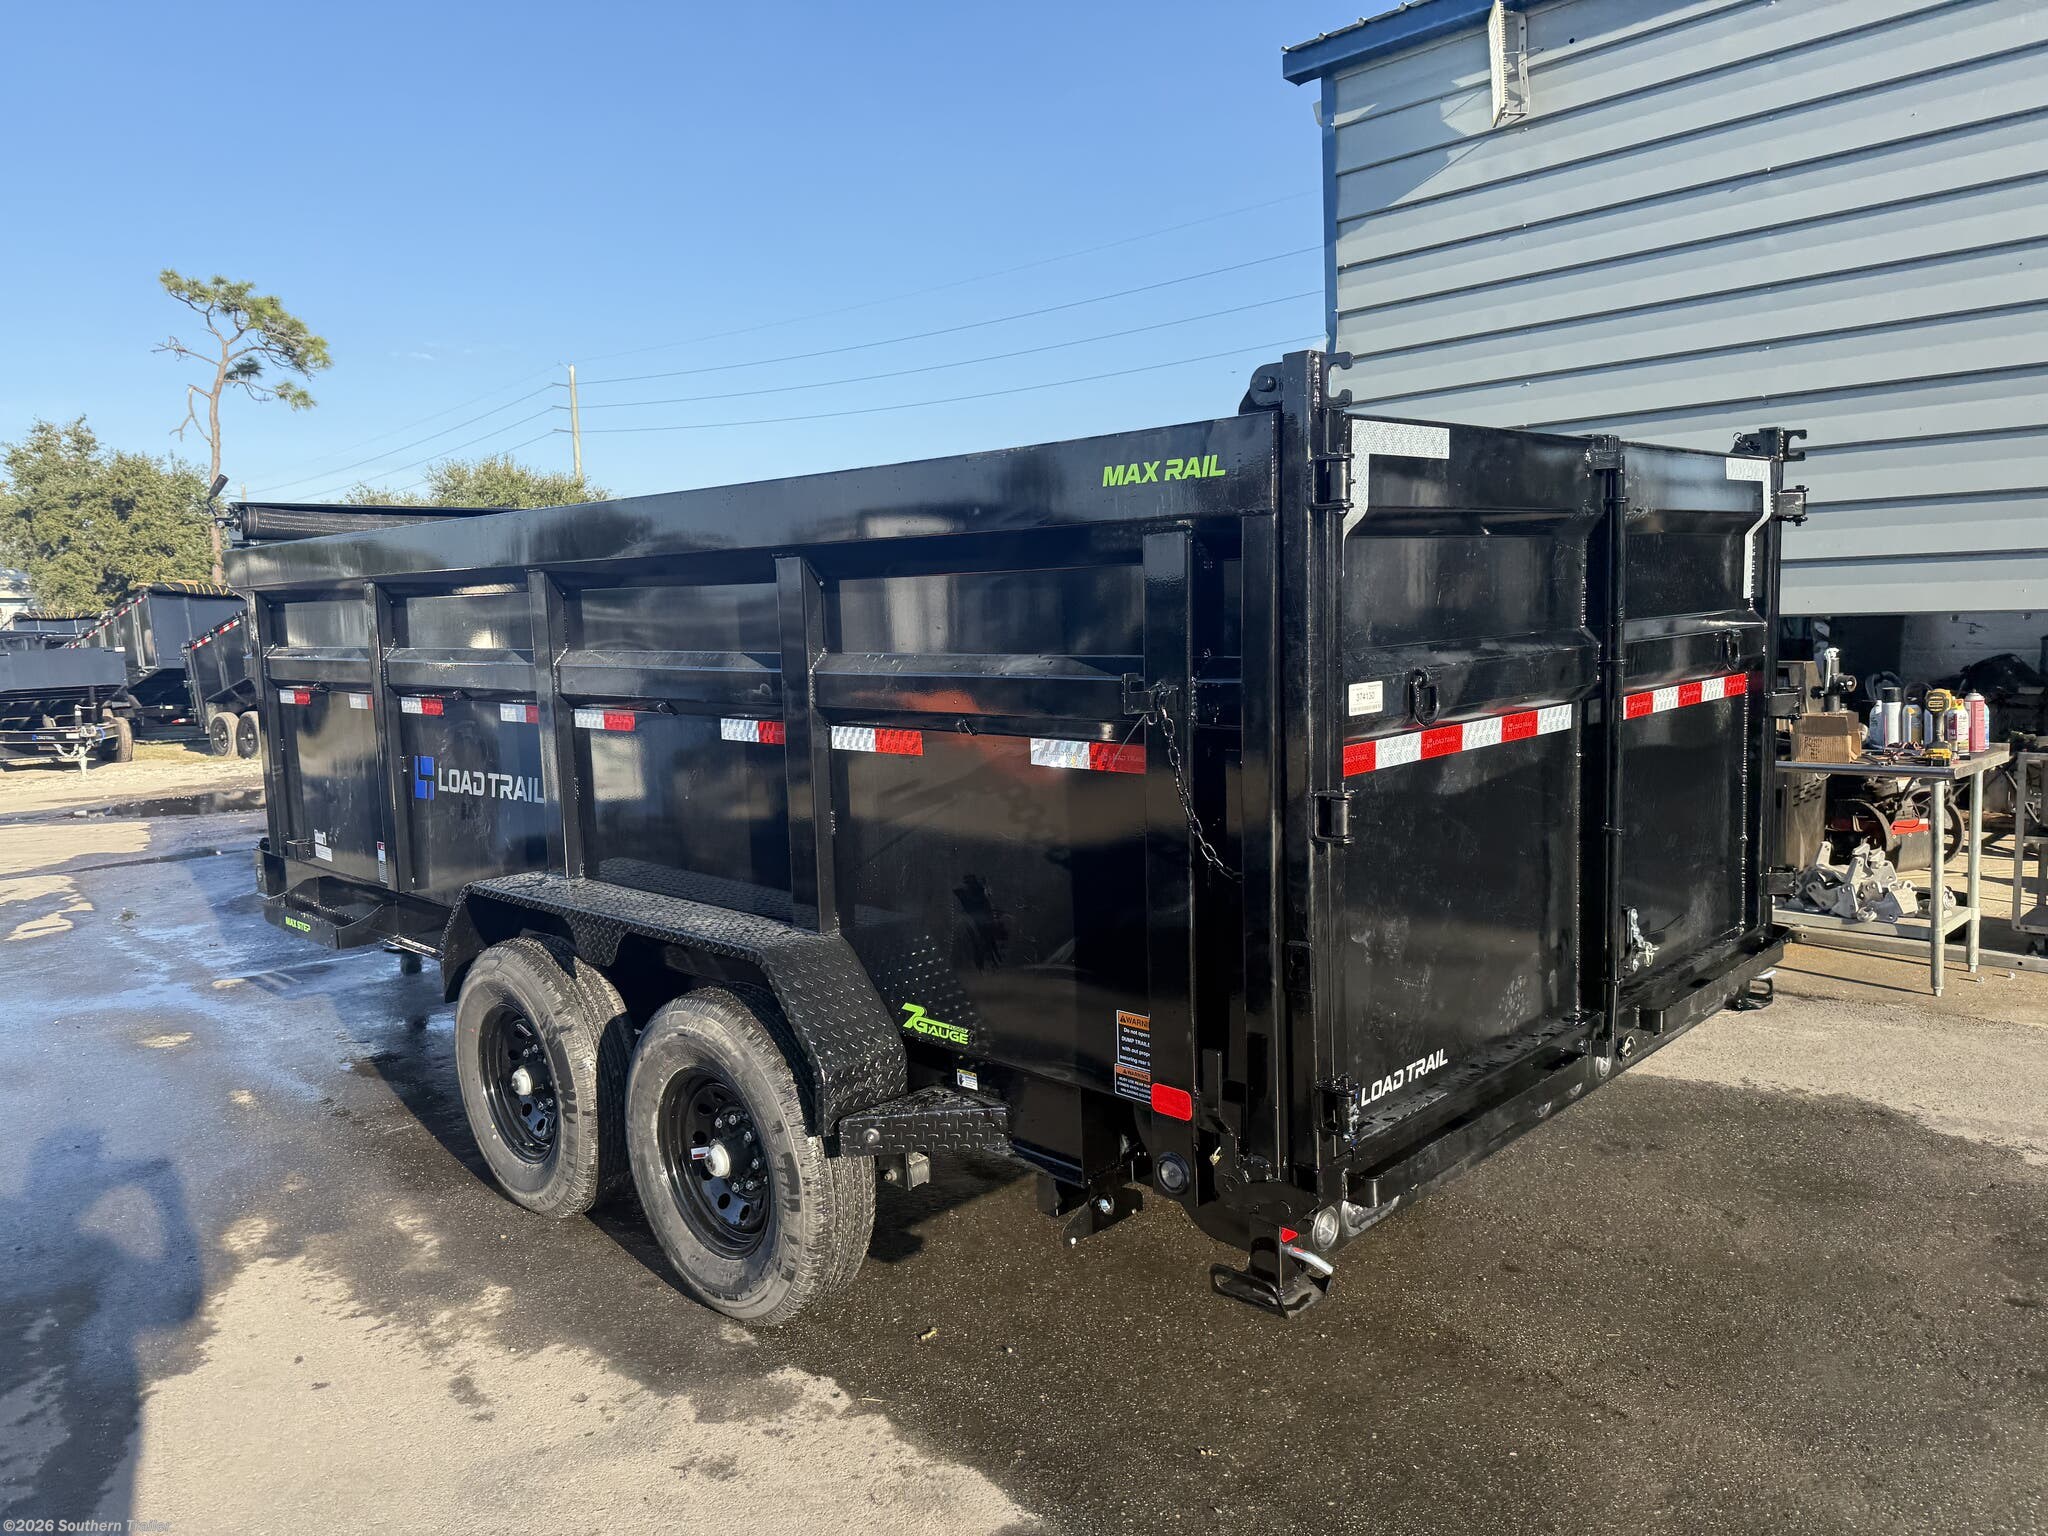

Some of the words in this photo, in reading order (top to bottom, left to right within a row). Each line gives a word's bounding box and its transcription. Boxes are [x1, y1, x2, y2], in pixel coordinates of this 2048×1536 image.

[1102, 460, 1160, 487] MAX
[1164, 454, 1226, 481] RAIL
[438, 767, 485, 796] LOAD
[487, 772, 545, 804] TRAIL
[901, 1002, 925, 1029] 7
[913, 1016, 969, 1045] GAUGE
[1361, 1069, 1404, 1107] LOAD
[1406, 1048, 1448, 1083] TRAIL
